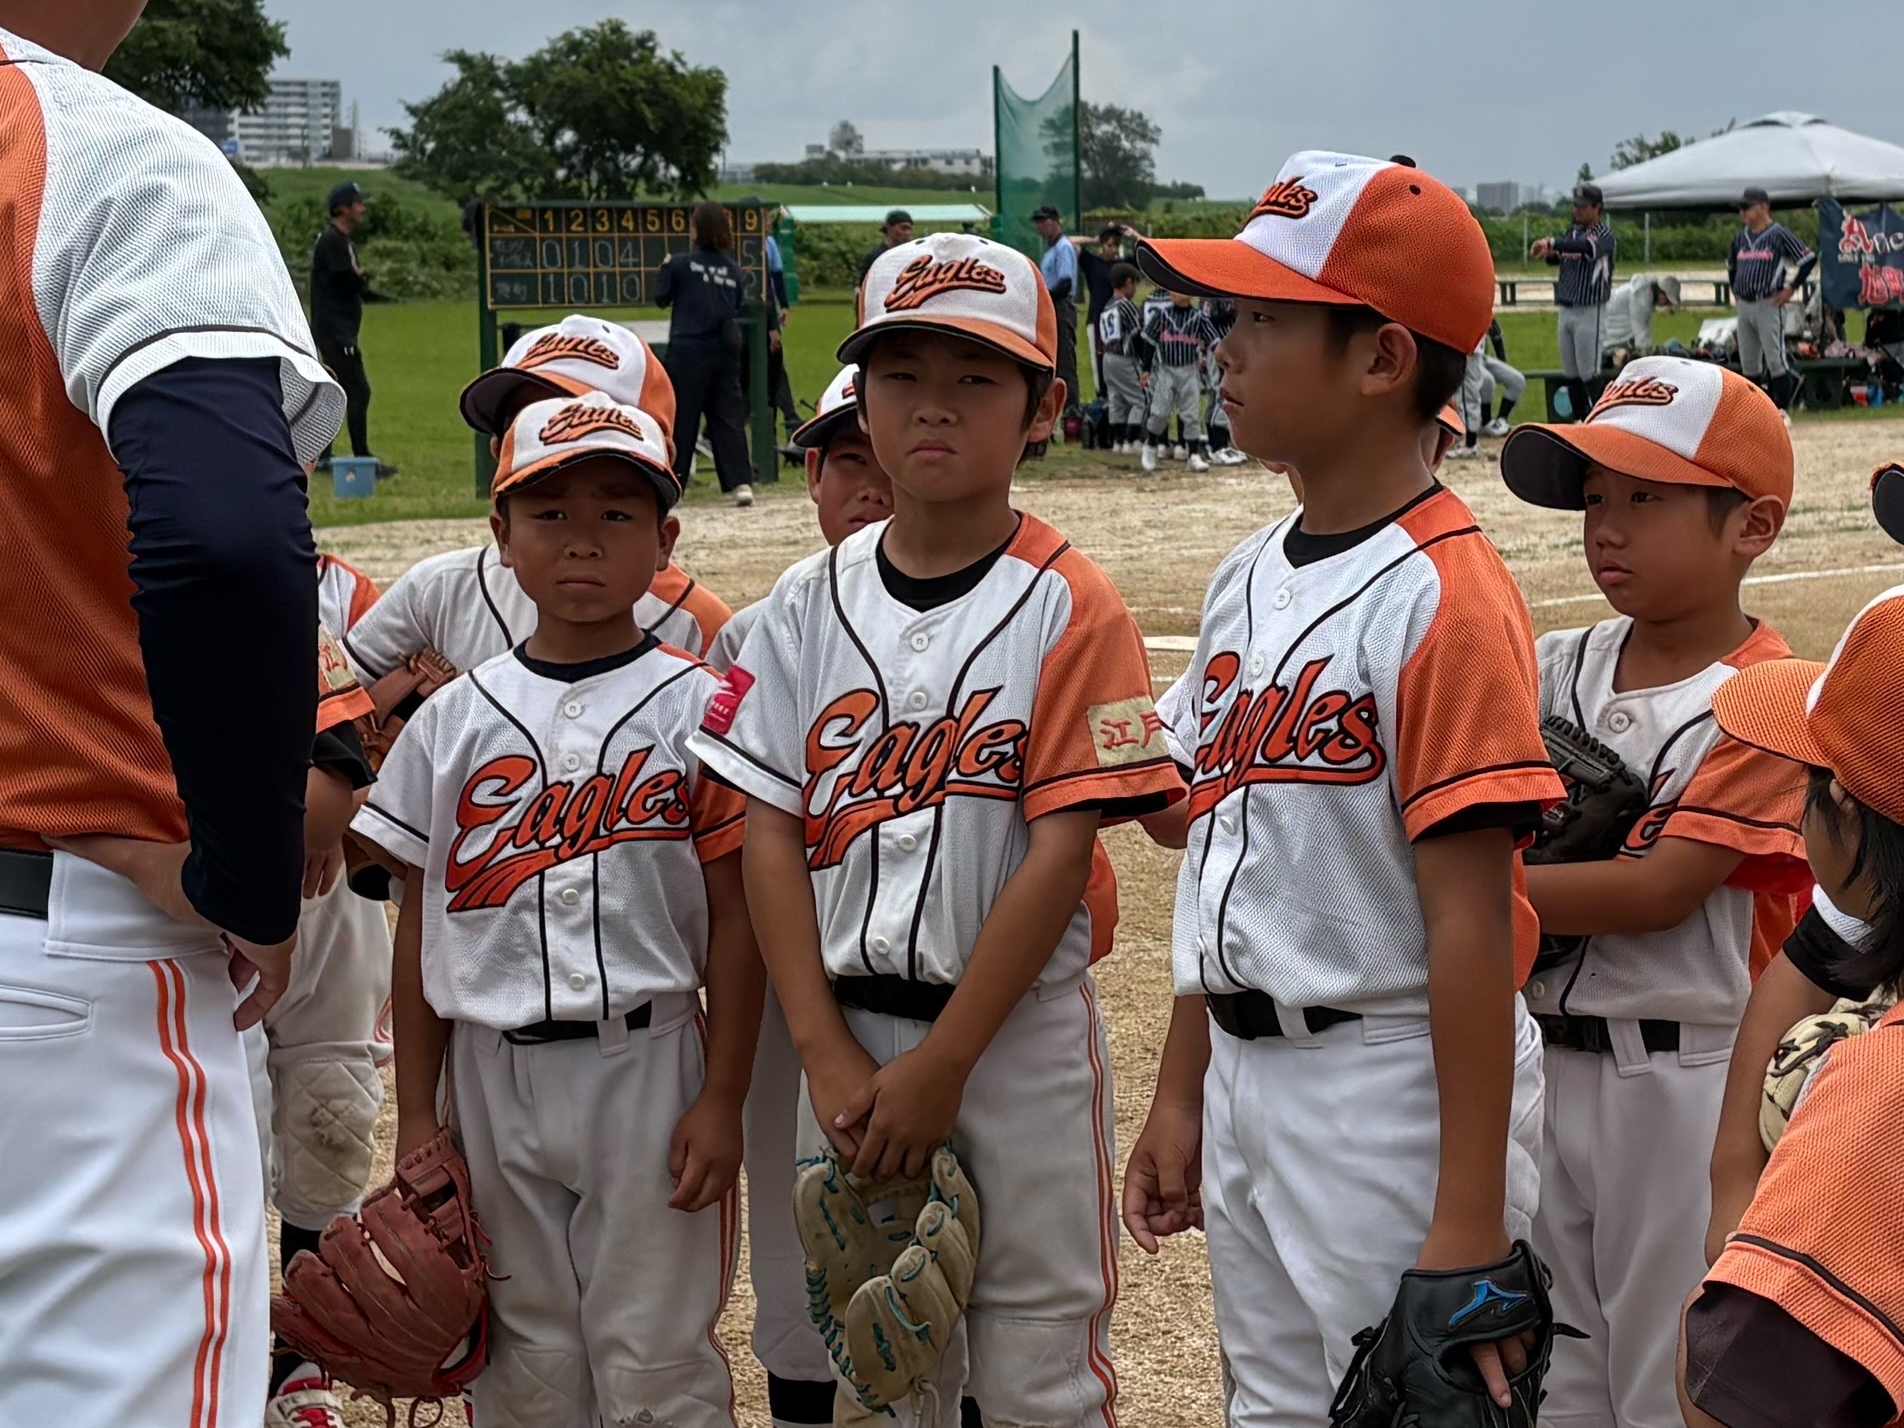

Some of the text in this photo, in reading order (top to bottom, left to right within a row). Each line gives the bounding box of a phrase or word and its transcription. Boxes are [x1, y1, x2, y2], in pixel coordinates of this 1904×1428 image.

[544, 209, 555, 232] 1
[569, 209, 585, 232] 2
[595, 209, 610, 232] 3
[621, 209, 635, 231] 4
[646, 209, 660, 232] 5
[671, 209, 685, 232] 6
[744, 209, 758, 231] 9
[619, 241, 639, 267] 4
[883, 254, 1007, 313] Eagles
[1187, 651, 1387, 825] Eagles
[445, 743, 691, 913] Eagles
